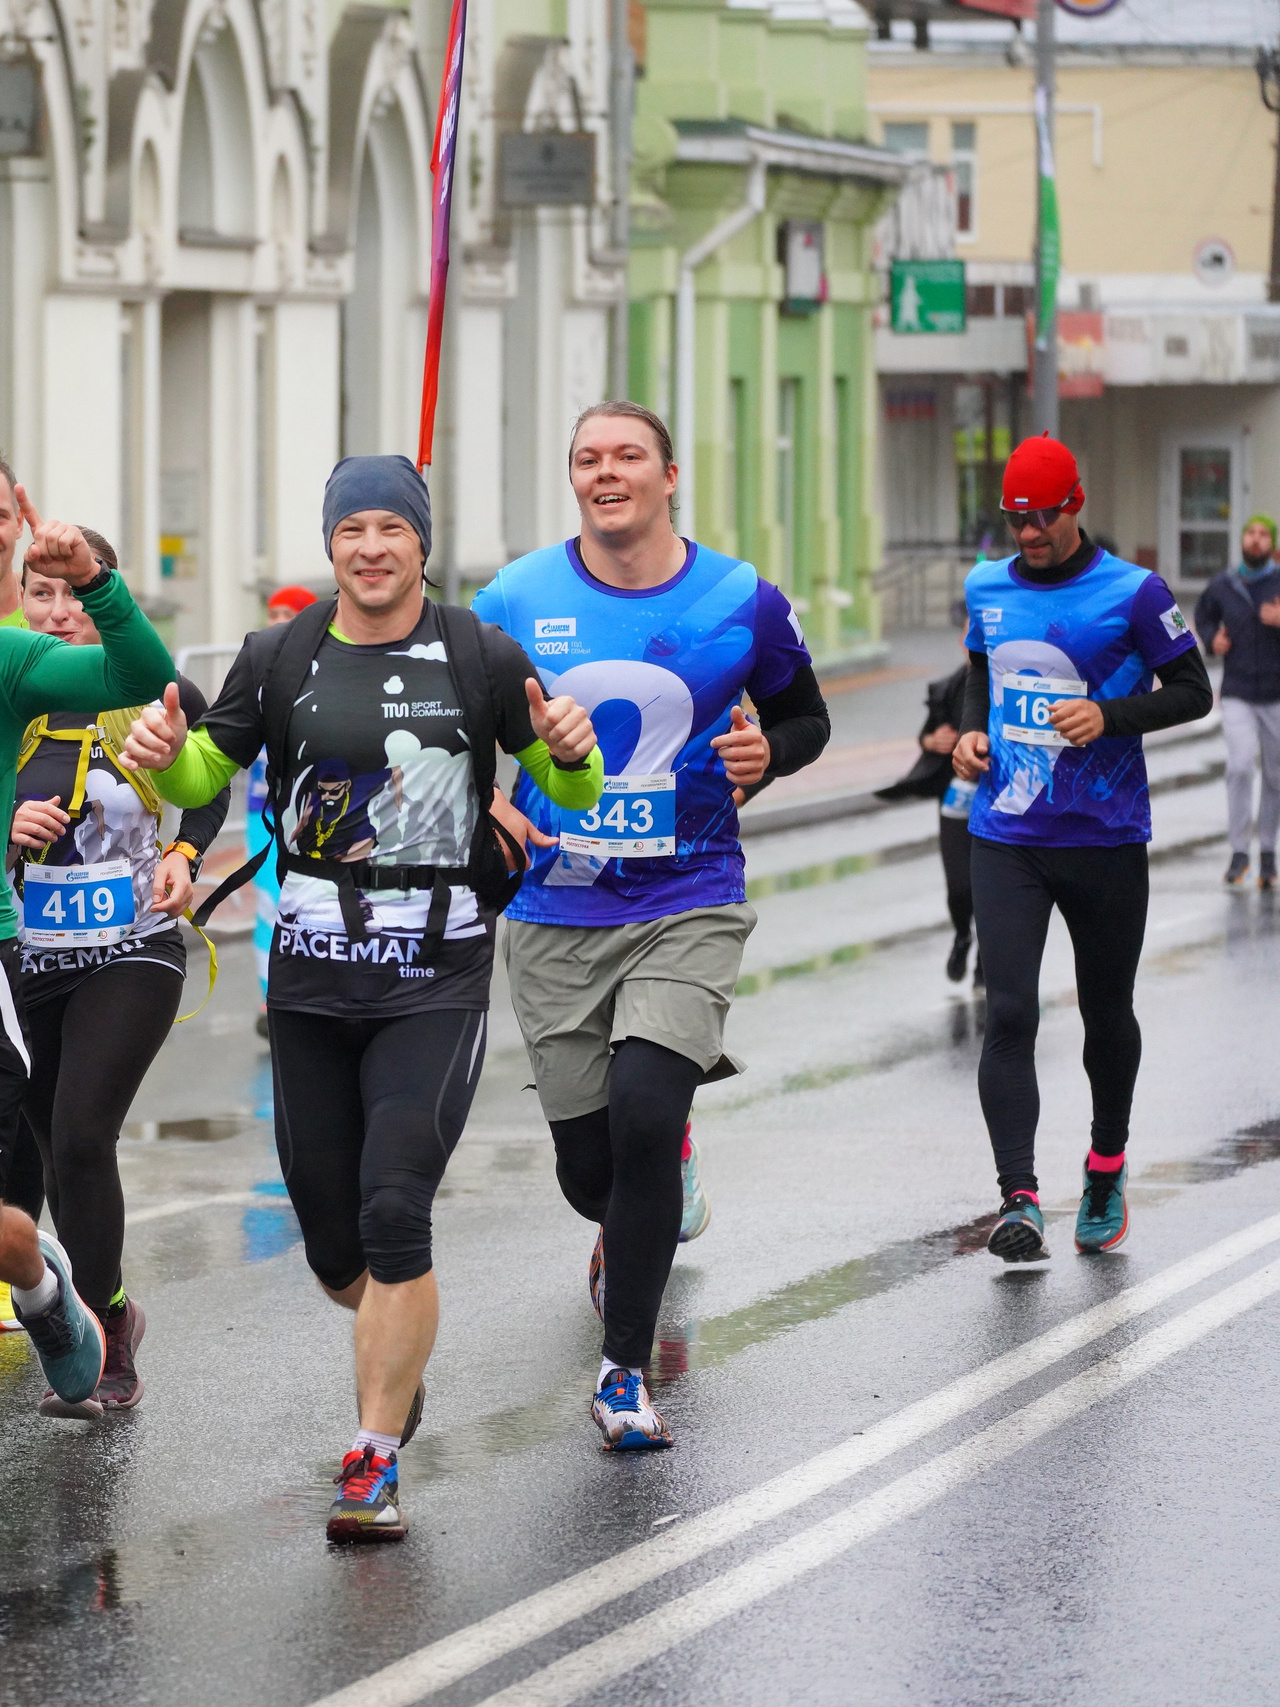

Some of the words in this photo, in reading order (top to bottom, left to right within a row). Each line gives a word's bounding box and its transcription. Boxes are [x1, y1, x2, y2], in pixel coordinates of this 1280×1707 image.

[540, 641, 570, 655] 2024
[410, 701, 442, 710] SPORT
[1016, 694, 1069, 727] 16
[579, 798, 654, 833] 343
[41, 886, 116, 925] 419
[398, 965, 435, 978] time
